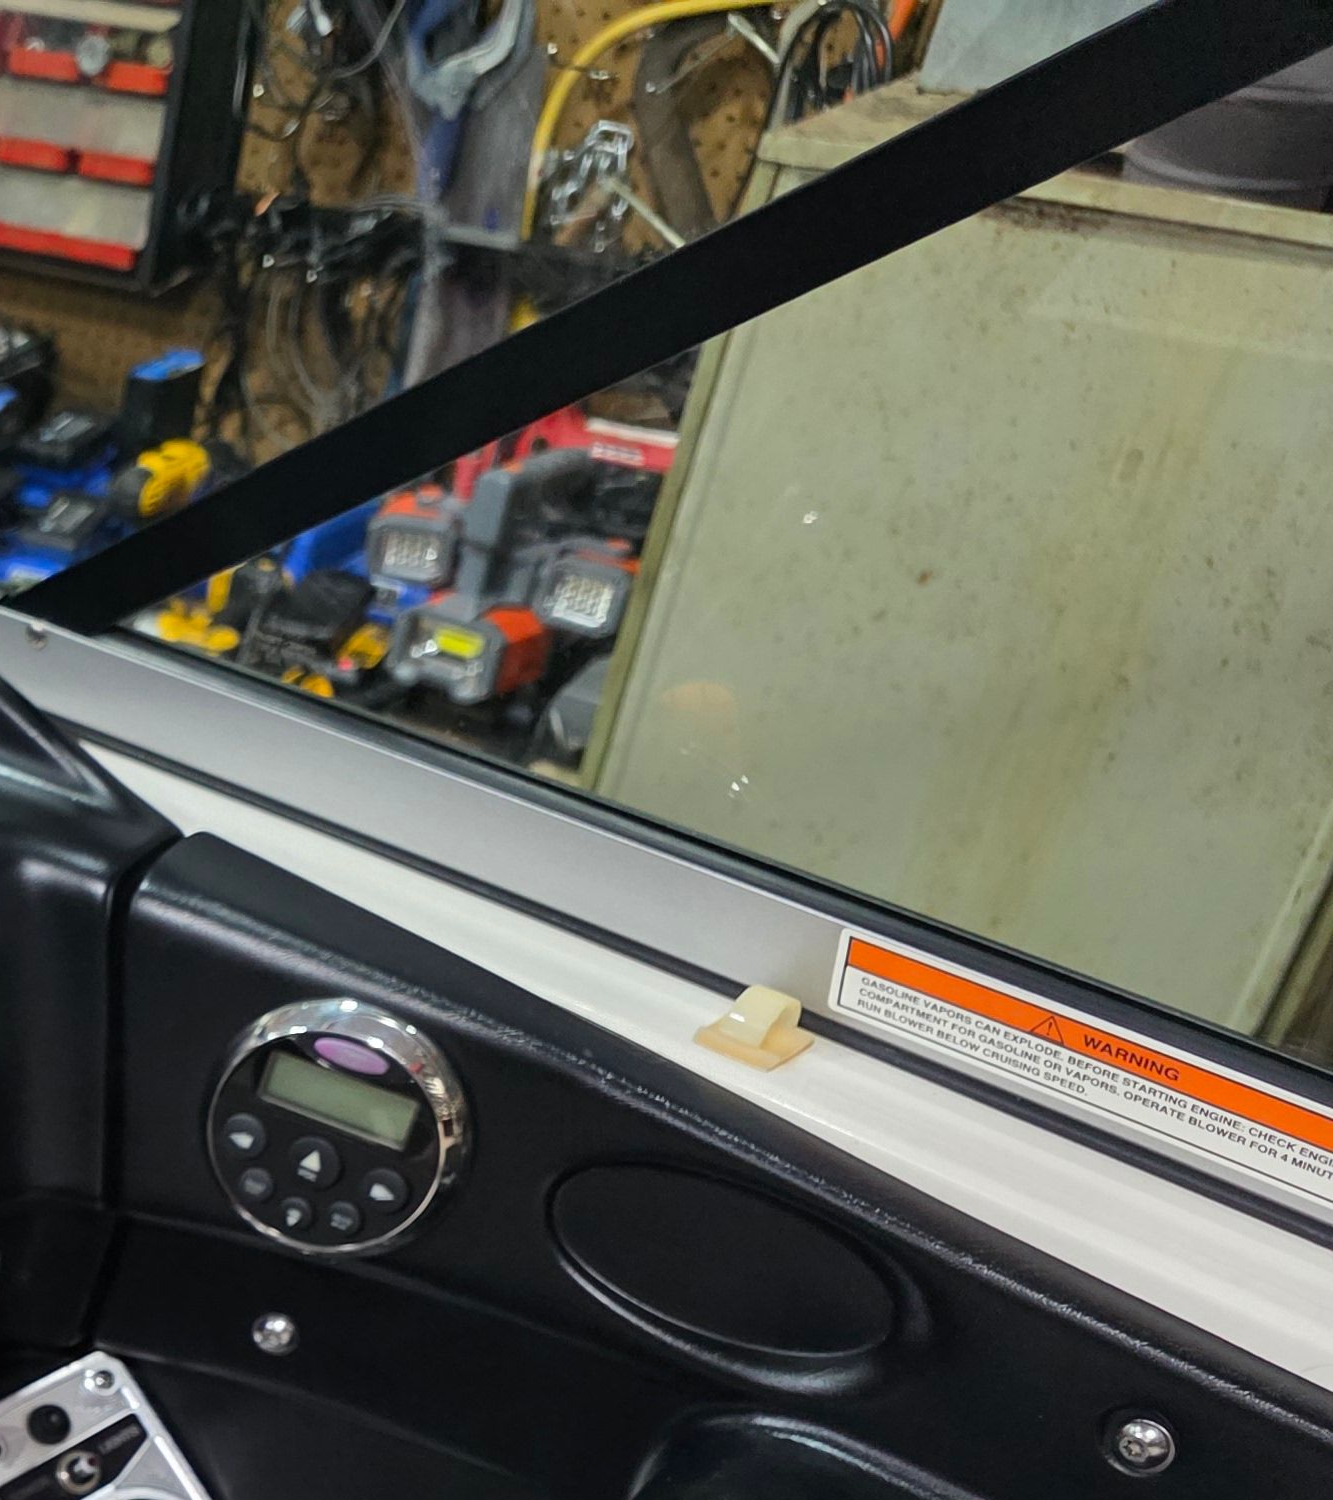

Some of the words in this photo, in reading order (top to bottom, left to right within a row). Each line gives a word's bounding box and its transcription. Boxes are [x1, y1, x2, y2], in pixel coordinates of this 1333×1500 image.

[857, 999, 882, 1014] RUN
[884, 1009, 934, 1035] BLOWER
[936, 1029, 982, 1052] BELOW
[982, 1048, 1041, 1077] CRUISING
[1043, 1071, 1088, 1096] SPEED.
[859, 987, 948, 1029] COMPARTMENT
[951, 1023, 976, 1040] FOR
[978, 1034, 1041, 1064] GASOLINE
[1043, 1059, 1068, 1073] OR
[1066, 1066, 1120, 1096] VAPORS.
[1123, 1091, 1185, 1122] OPERATE
[1188, 1116, 1246, 1146] BLOWER
[1249, 1140, 1277, 1158] FOR
[1280, 1154, 1288, 1163] 4
[862, 977, 920, 1007] GASOLINE
[924, 999, 972, 1025] VAPORS
[975, 1020, 1001, 1037] CAN
[1003, 1030, 1064, 1062] EXPLODE.
[1068, 1055, 1119, 1083] BEFORE
[1122, 1077, 1187, 1109] STARTING
[1248, 1127, 1300, 1153] CHECK
[1299, 1147, 1333, 1168] ENGI
[1083, 1034, 1180, 1081] WARNING
